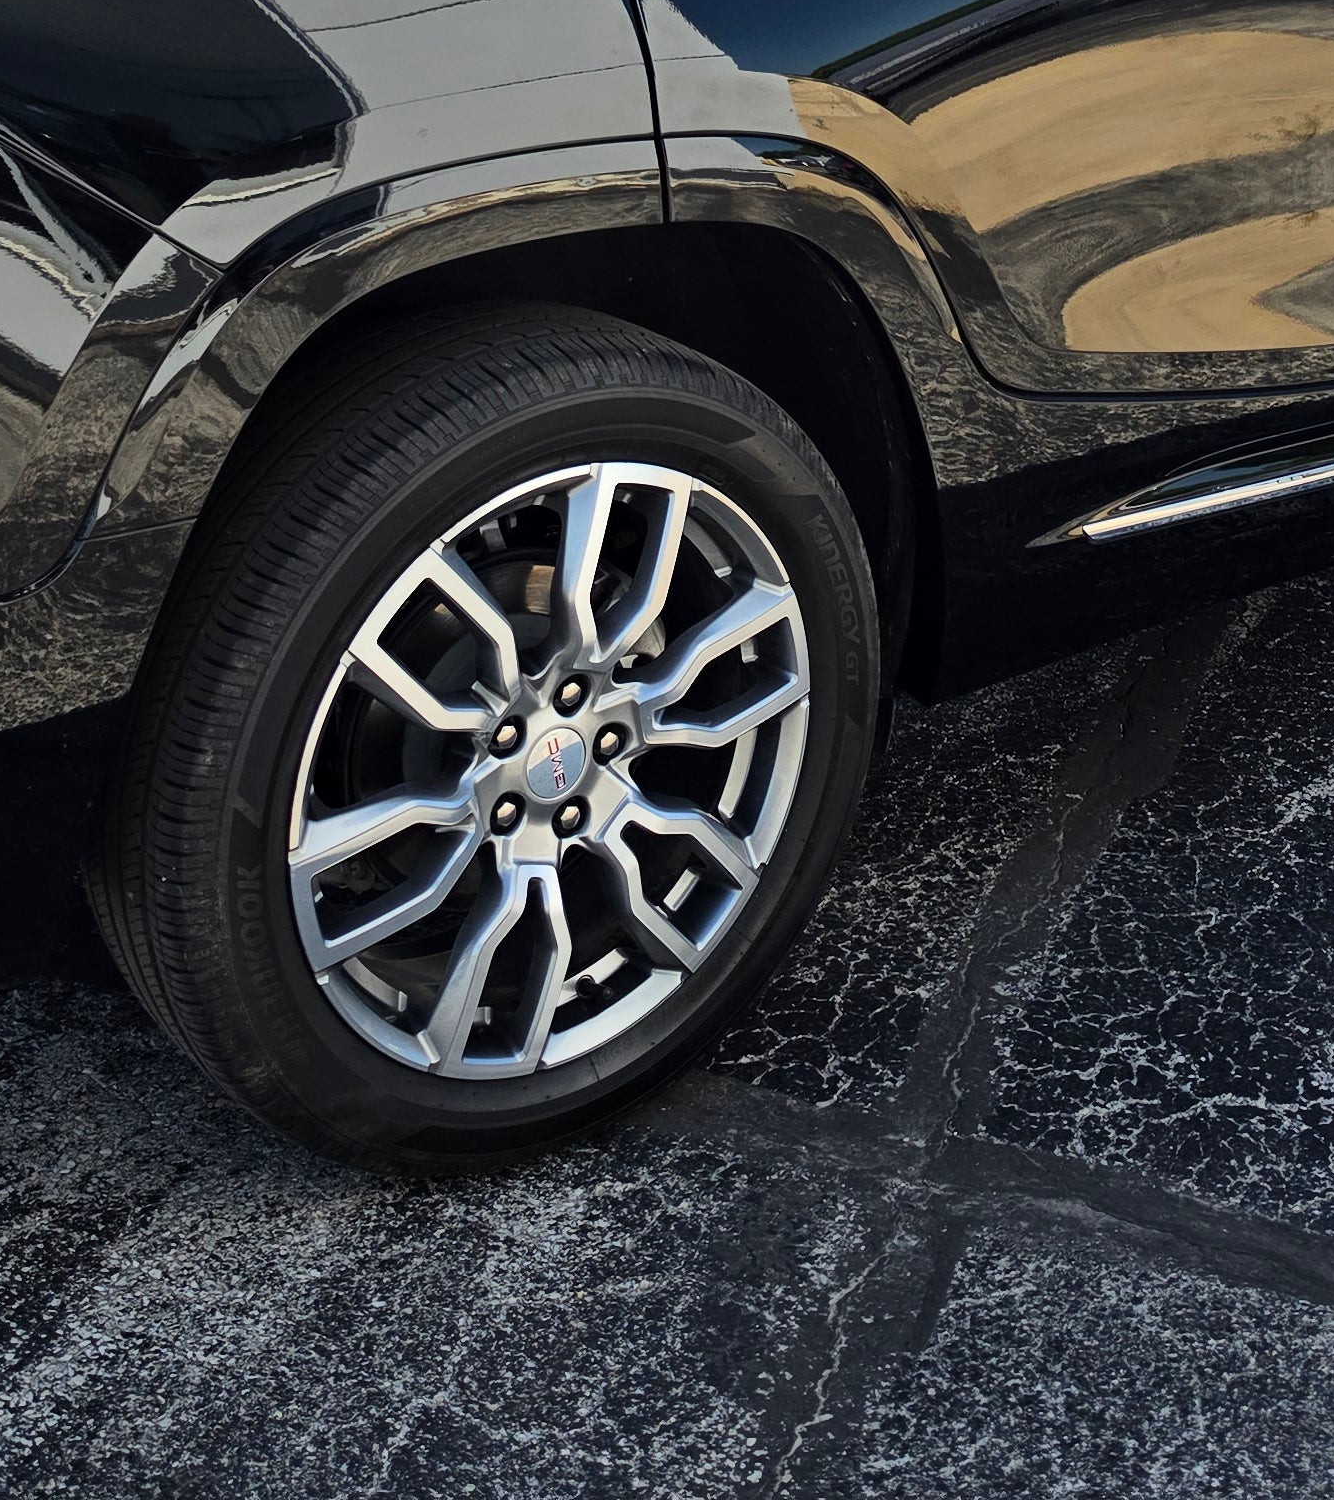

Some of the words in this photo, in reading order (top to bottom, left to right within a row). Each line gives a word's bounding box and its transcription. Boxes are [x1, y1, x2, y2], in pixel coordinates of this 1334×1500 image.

[804, 513, 861, 644] KINERGY
[845, 651, 861, 687] GT
[546, 737, 567, 791] GMC
